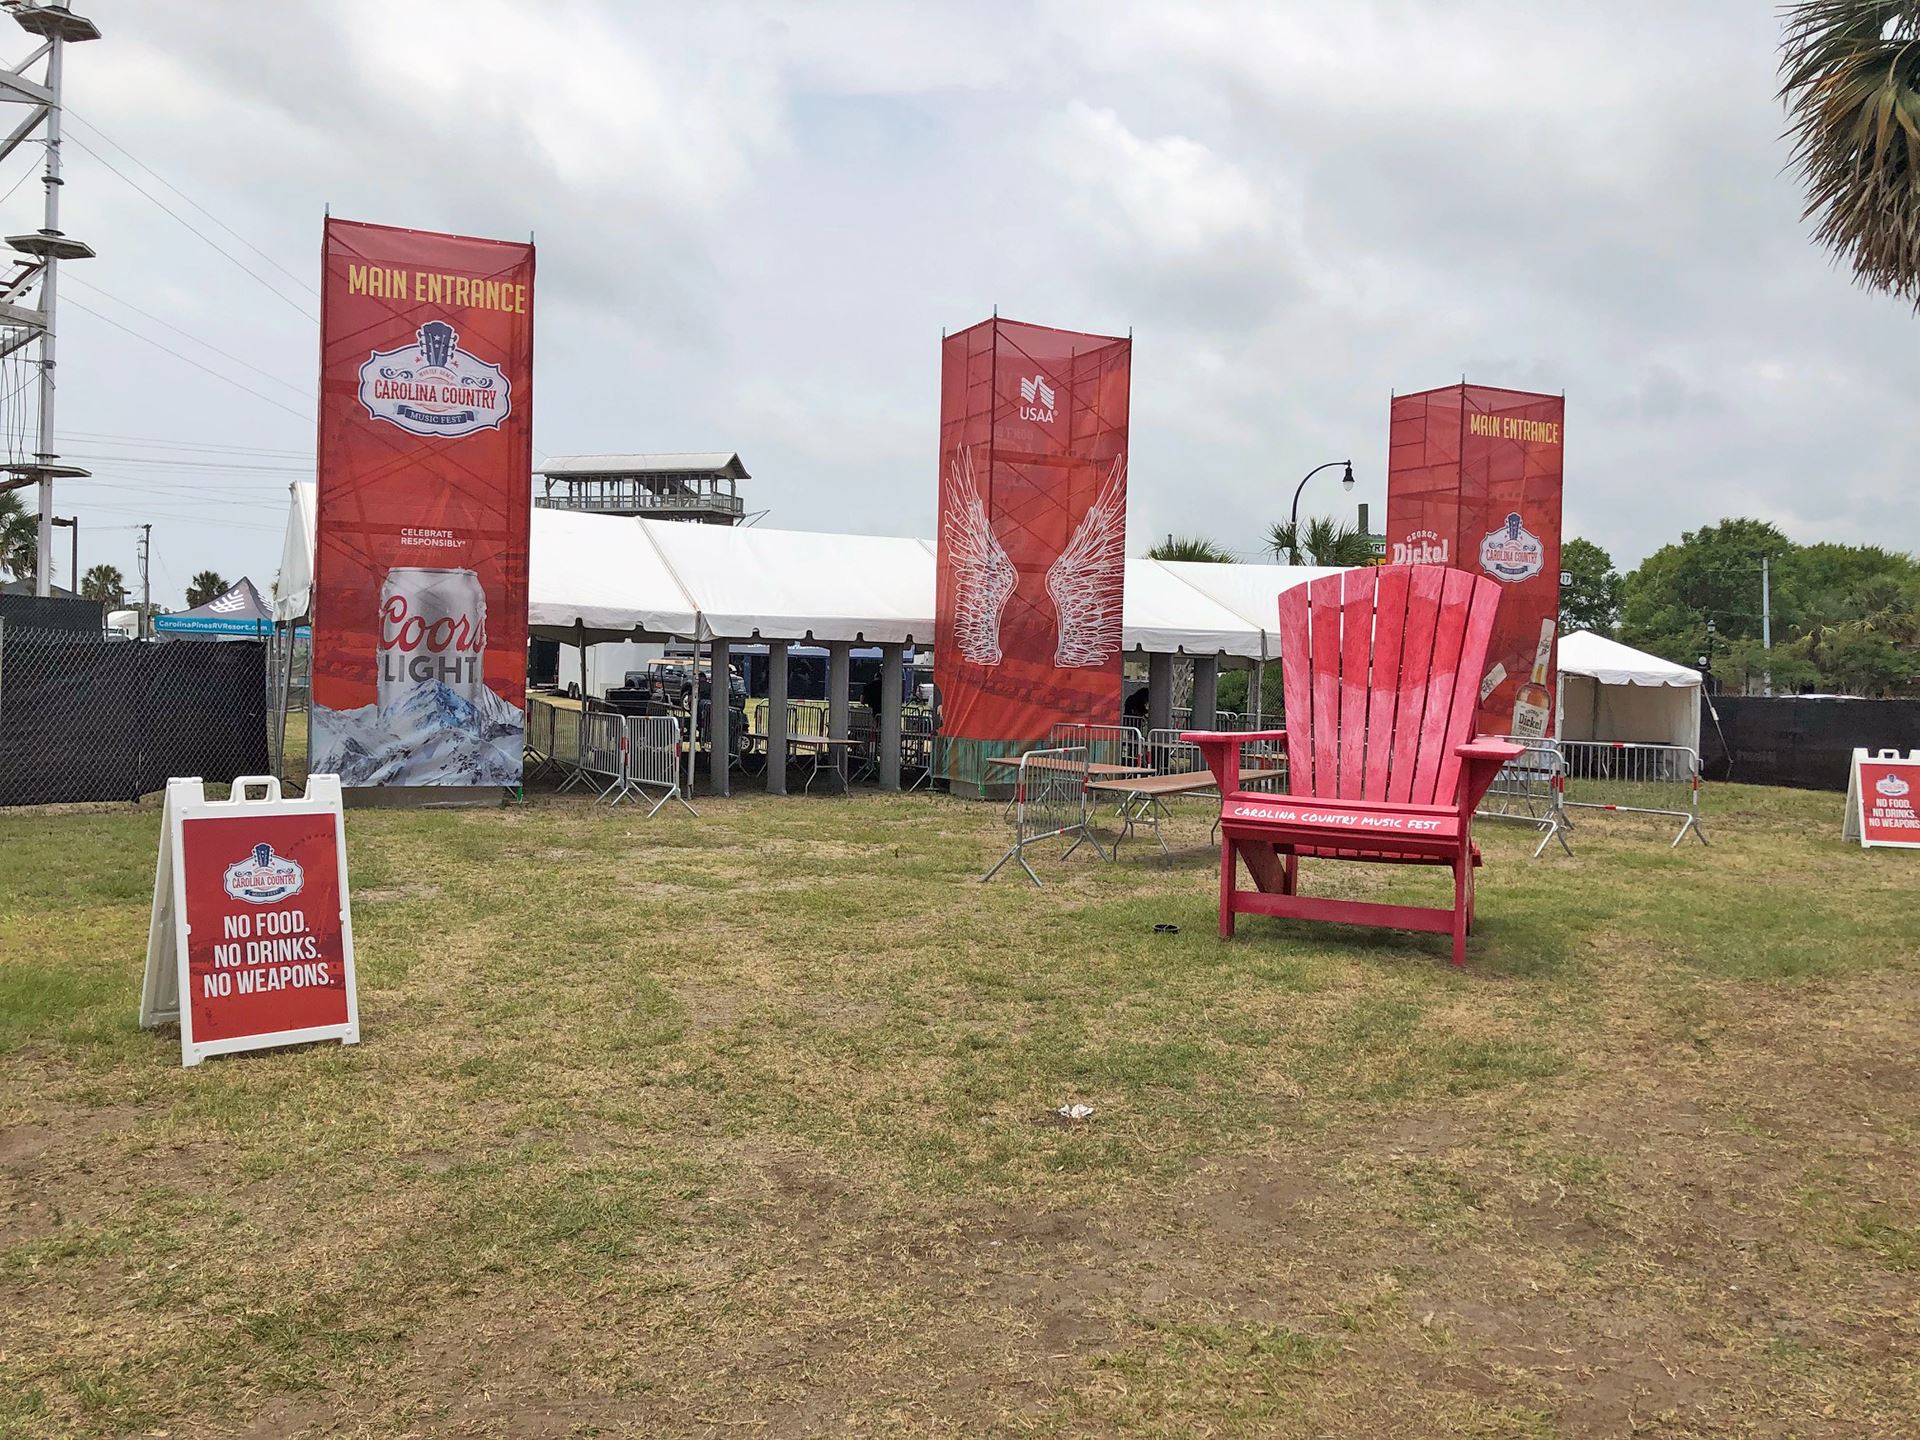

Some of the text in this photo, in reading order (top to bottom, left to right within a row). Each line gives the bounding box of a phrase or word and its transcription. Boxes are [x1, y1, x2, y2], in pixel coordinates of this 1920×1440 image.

[349, 264, 526, 314] MAIN ENTRANCE
[374, 379, 496, 410] CAROLINA COUNTRY
[410, 411, 461, 424] MUSIC FEST
[1020, 407, 1054, 423] USAA
[1470, 413, 1559, 444] MAIN ENTRANCE
[401, 528, 453, 538] CELEBRATE
[1406, 530, 1438, 543] GEORGE
[1392, 538, 1449, 565] Dickel
[1562, 574, 1570, 583] 17
[380, 595, 486, 653] Coors
[384, 655, 478, 684] LIGHT
[1518, 713, 1543, 731] Dickel
[1872, 808, 1884, 818] NO
[1876, 798, 1887, 807] NO
[1234, 806, 1441, 831] CAROLINA COUNTRY MUSIC FEST
[1868, 817, 1880, 827] NO
[232, 873, 296, 889] CAROLINA COUNTRY
[224, 910, 310, 939] NO FOOD.
[214, 937, 322, 968] NO DRINKS.
[204, 962, 335, 998] NO WEAPONS.
